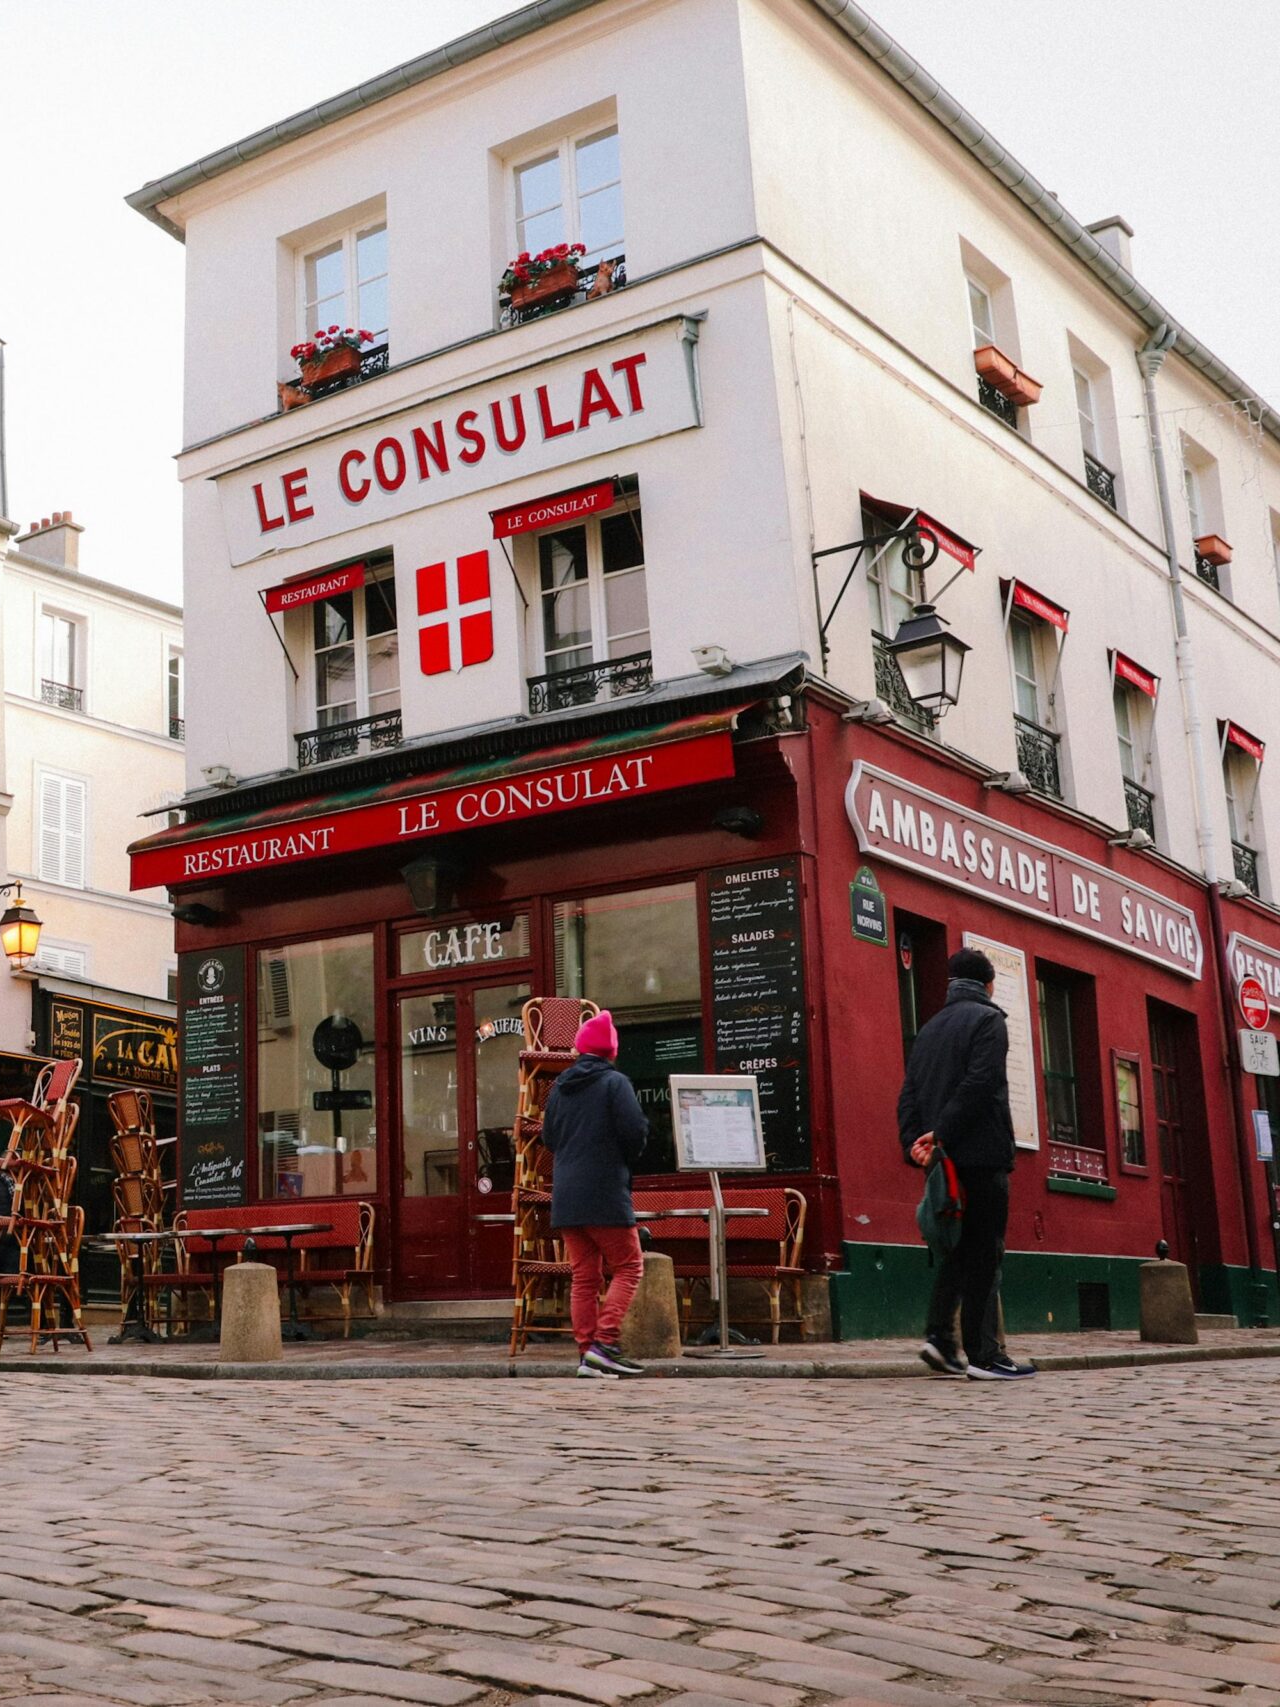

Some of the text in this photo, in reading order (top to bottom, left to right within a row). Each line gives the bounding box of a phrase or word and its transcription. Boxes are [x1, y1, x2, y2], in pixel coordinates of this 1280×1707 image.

[252, 352, 647, 534] LE CONSULAT
[506, 493, 599, 531] LE CONSULAT
[280, 573, 349, 606] RESTAURANT
[183, 755, 655, 877] RESTAURANT LE CONSULAT
[725, 868, 780, 884] OMELETTES
[867, 788, 1050, 902] AMBASSADE
[1072, 872, 1102, 922] DE
[1121, 900, 1196, 963] SAVOIE
[862, 898, 875, 913] RUE
[856, 914, 882, 932] NORVINS
[423, 922, 503, 968] CAFE
[732, 929, 775, 944] SALADES
[199, 995, 224, 1005] ENTRÉES
[56, 1010, 79, 1022] Maison
[408, 1026, 448, 1045] VINS
[476, 1017, 525, 1044] LIQUEUR
[1250, 1034, 1268, 1045] SAUF
[118, 1040, 134, 1060] LA
[118, 1062, 131, 1076] LA
[202, 1064, 221, 1074] PLATS
[740, 1058, 778, 1070] CRÊPES
